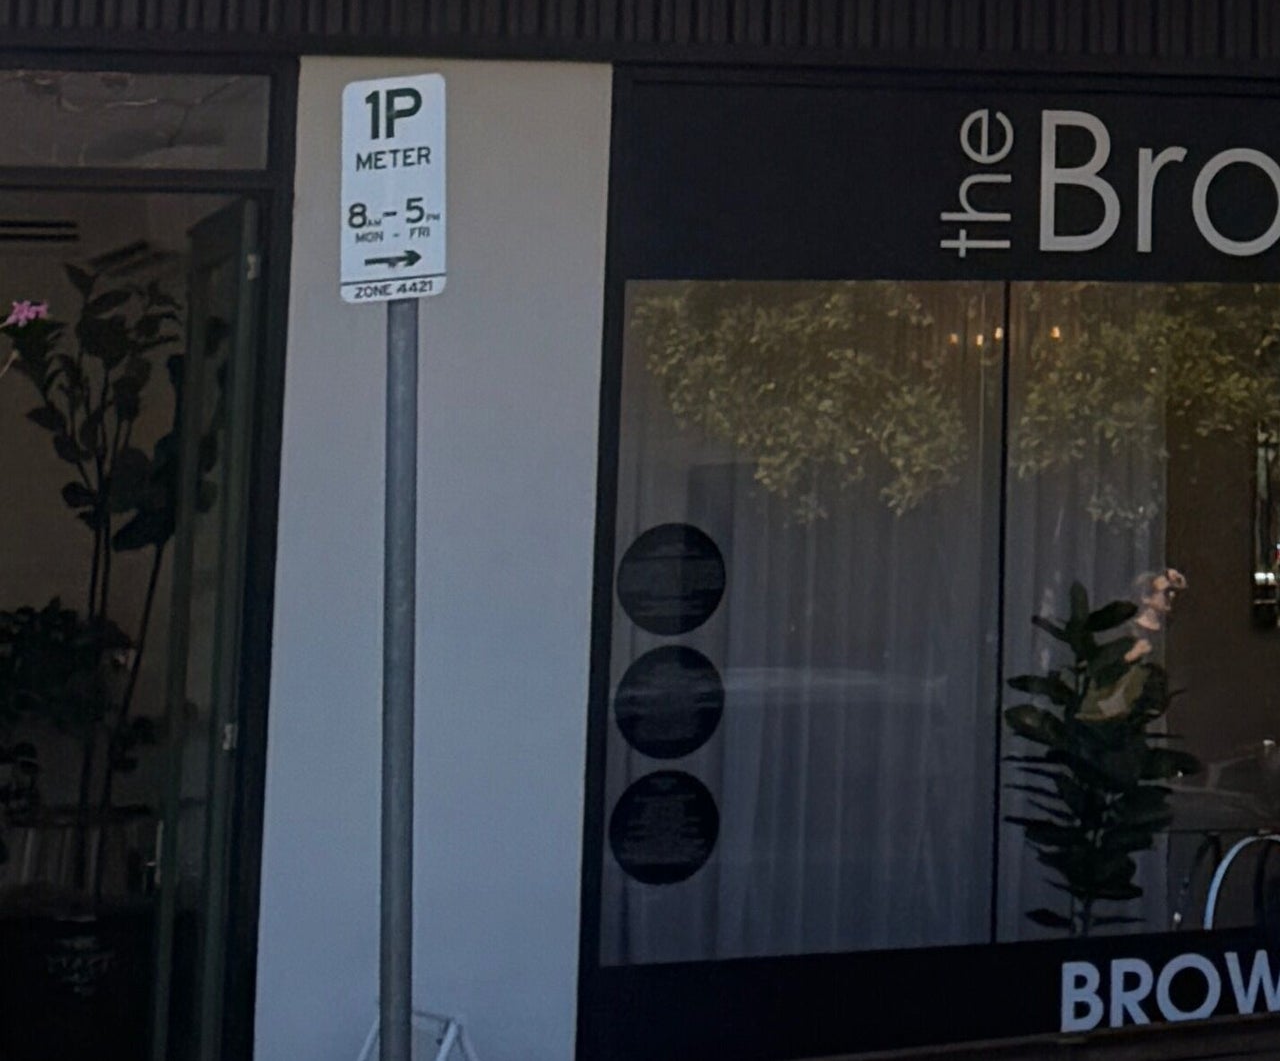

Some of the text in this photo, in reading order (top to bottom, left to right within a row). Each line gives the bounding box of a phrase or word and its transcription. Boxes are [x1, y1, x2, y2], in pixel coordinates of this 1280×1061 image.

[365, 87, 423, 140] 1P
[356, 146, 432, 172] METER
[940, 108, 1014, 258] the
[355, 231, 384, 244] MON
[409, 227, 431, 239] FRI
[354, 280, 434, 299] ZONE 4421
